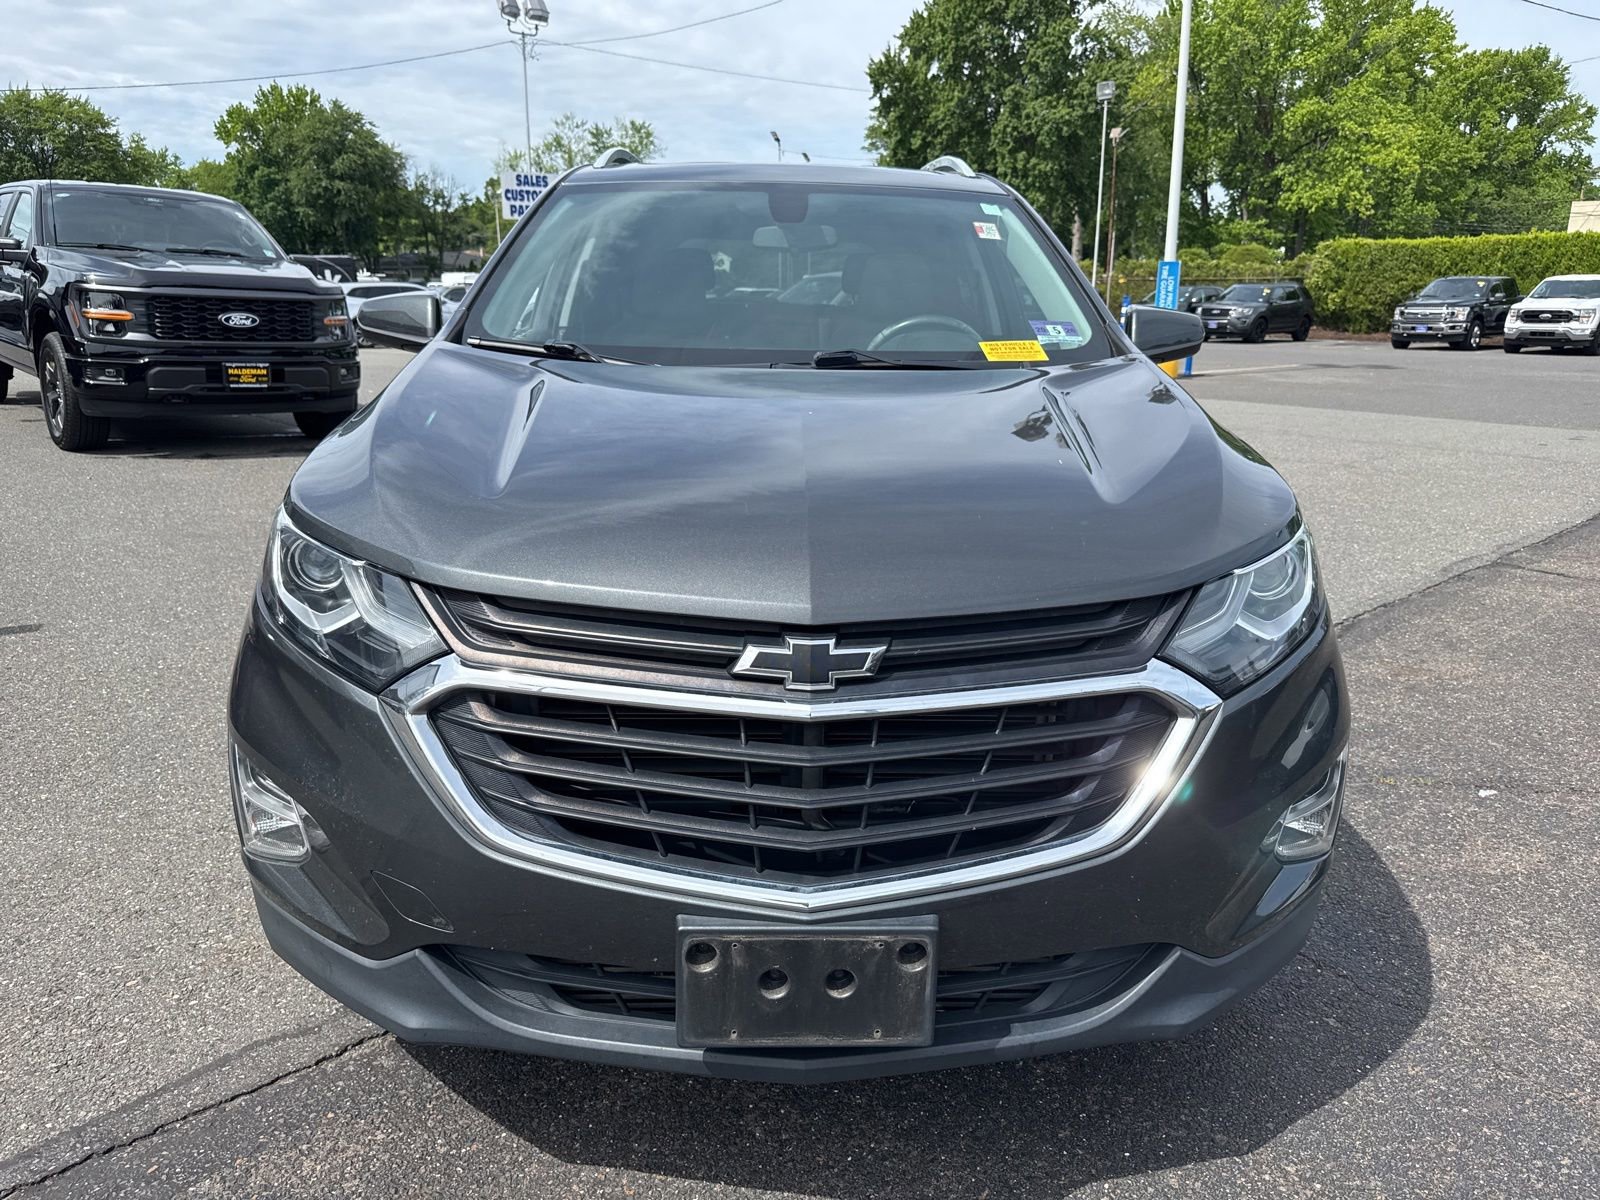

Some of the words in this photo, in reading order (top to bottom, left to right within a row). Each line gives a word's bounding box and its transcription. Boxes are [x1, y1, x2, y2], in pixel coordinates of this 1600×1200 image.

[516, 174, 548, 187] SALES
[504, 189, 542, 202] CUSTO
[1161, 265, 1169, 280] TIRE
[1167, 276, 1175, 292] LOW
[229, 315, 252, 326] Ford
[1052, 326, 1061, 335] 5
[240, 375, 257, 383] Ford
